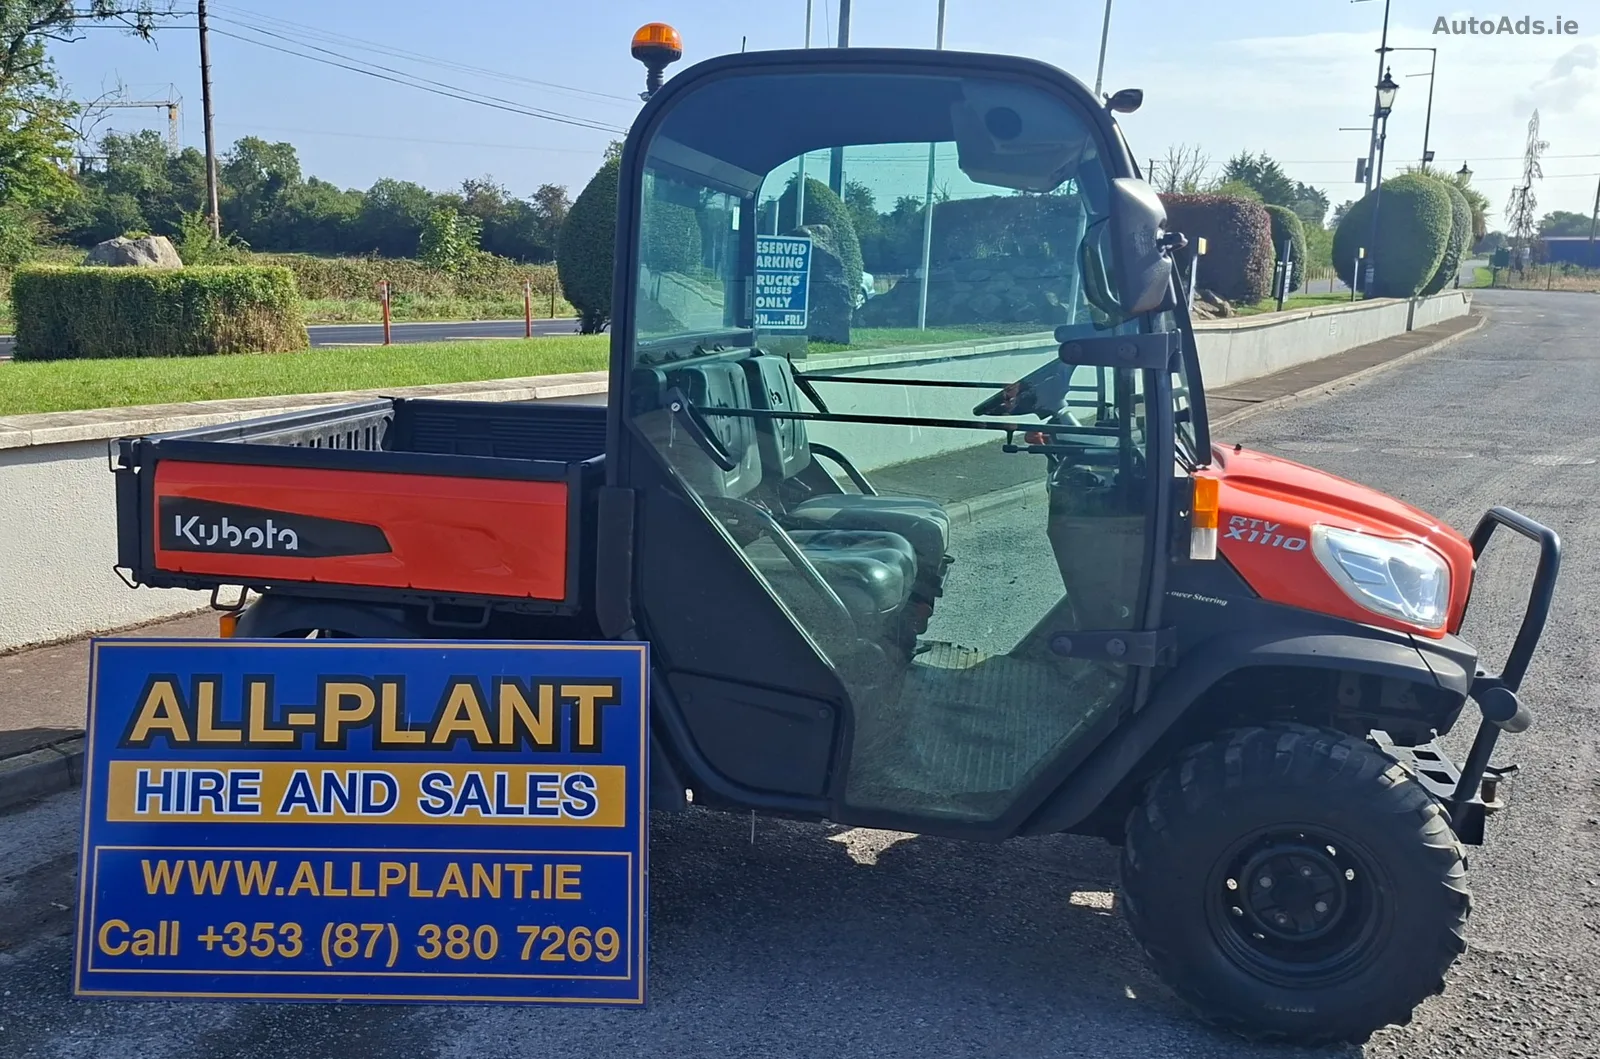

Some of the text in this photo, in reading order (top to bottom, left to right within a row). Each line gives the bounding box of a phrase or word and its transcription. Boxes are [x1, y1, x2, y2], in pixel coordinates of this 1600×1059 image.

[756, 241, 807, 254] ESERVED
[756, 255, 803, 268] ARKING
[756, 274, 800, 287] RUCKS
[755, 296, 792, 308] ONLY
[174, 514, 299, 551] Kubota
[1229, 515, 1280, 531] RTV
[1223, 526, 1307, 551] X1110
[1166, 589, 1229, 607] ower Steering
[124, 676, 618, 750] ALL-PLANT
[135, 768, 598, 819] HIRE AND SALES
[141, 859, 583, 900] WWW.ALLPLANT.IE
[97, 919, 621, 967] Call +353 (87) 380 7269
